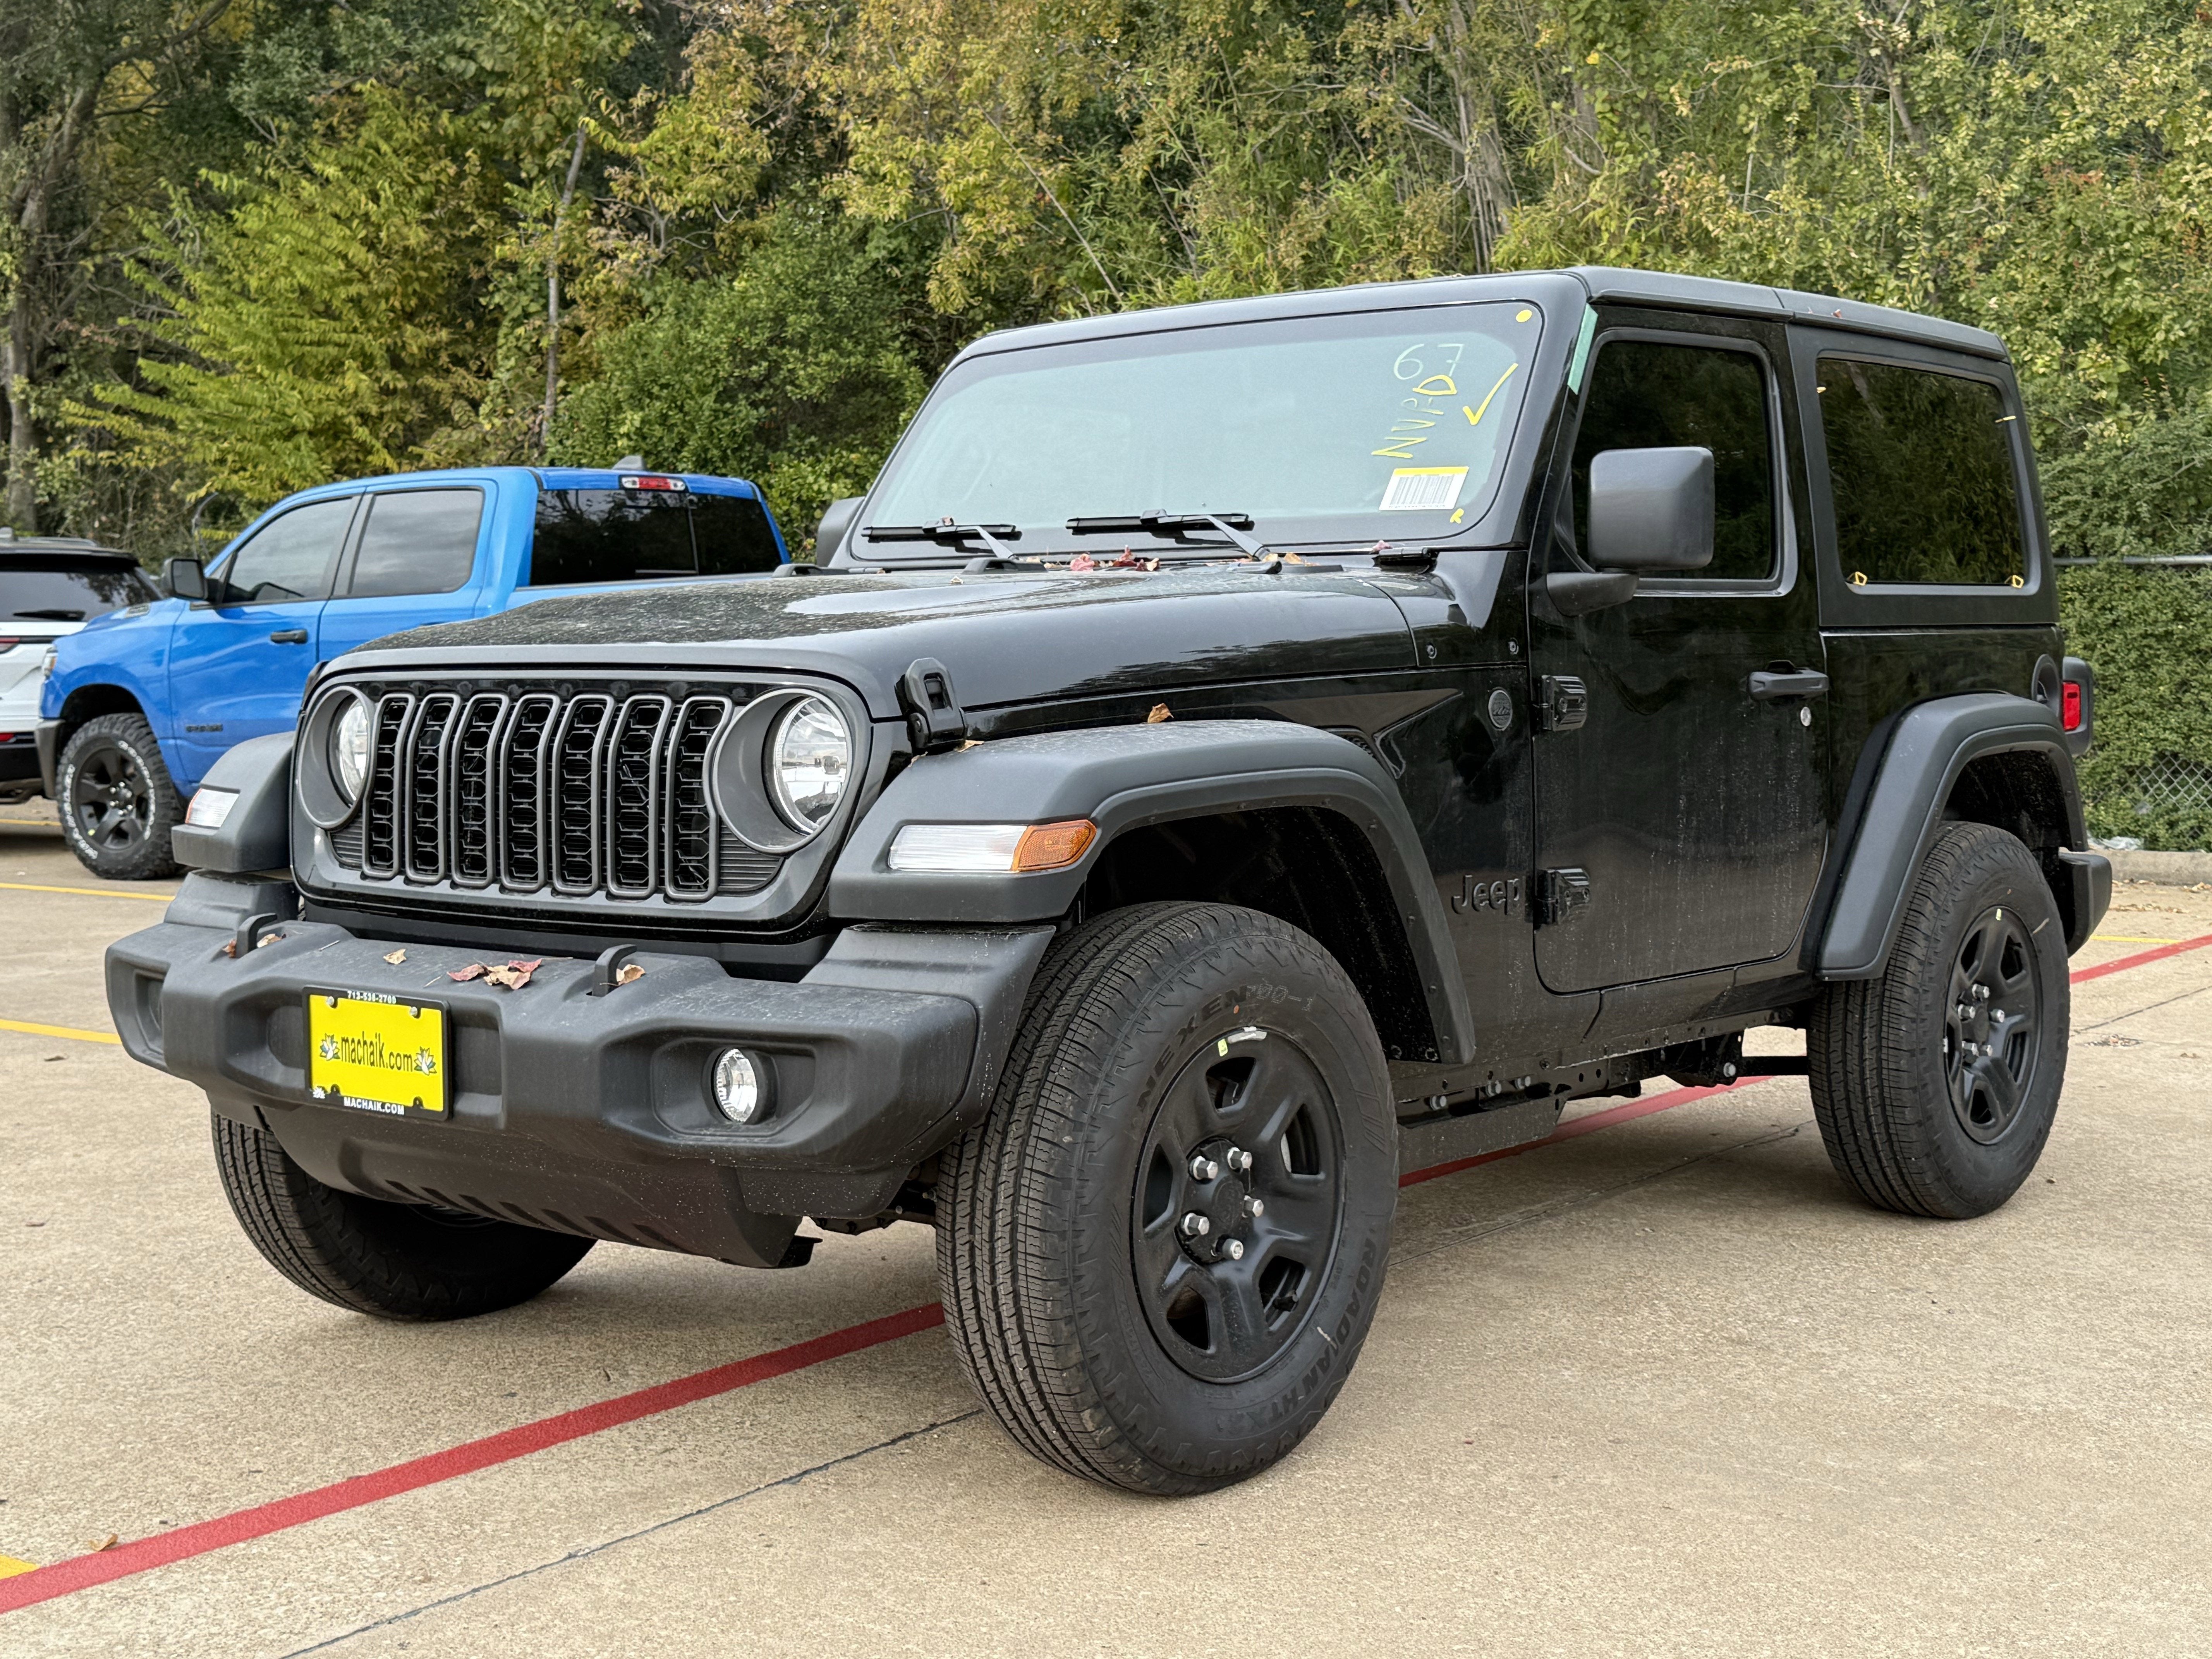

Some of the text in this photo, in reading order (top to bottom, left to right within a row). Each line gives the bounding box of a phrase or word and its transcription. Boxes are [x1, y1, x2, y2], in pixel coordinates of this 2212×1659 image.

[1393, 343, 1465, 380] 67
[1451, 874, 1520, 915] Jeep
[341, 1031, 413, 1072] machaik.com
[1136, 984, 1249, 1113] NEXEN
[344, 1096, 405, 1115] MACHAIK.COM
[1304, 1238, 1377, 1395] ROADIAN
